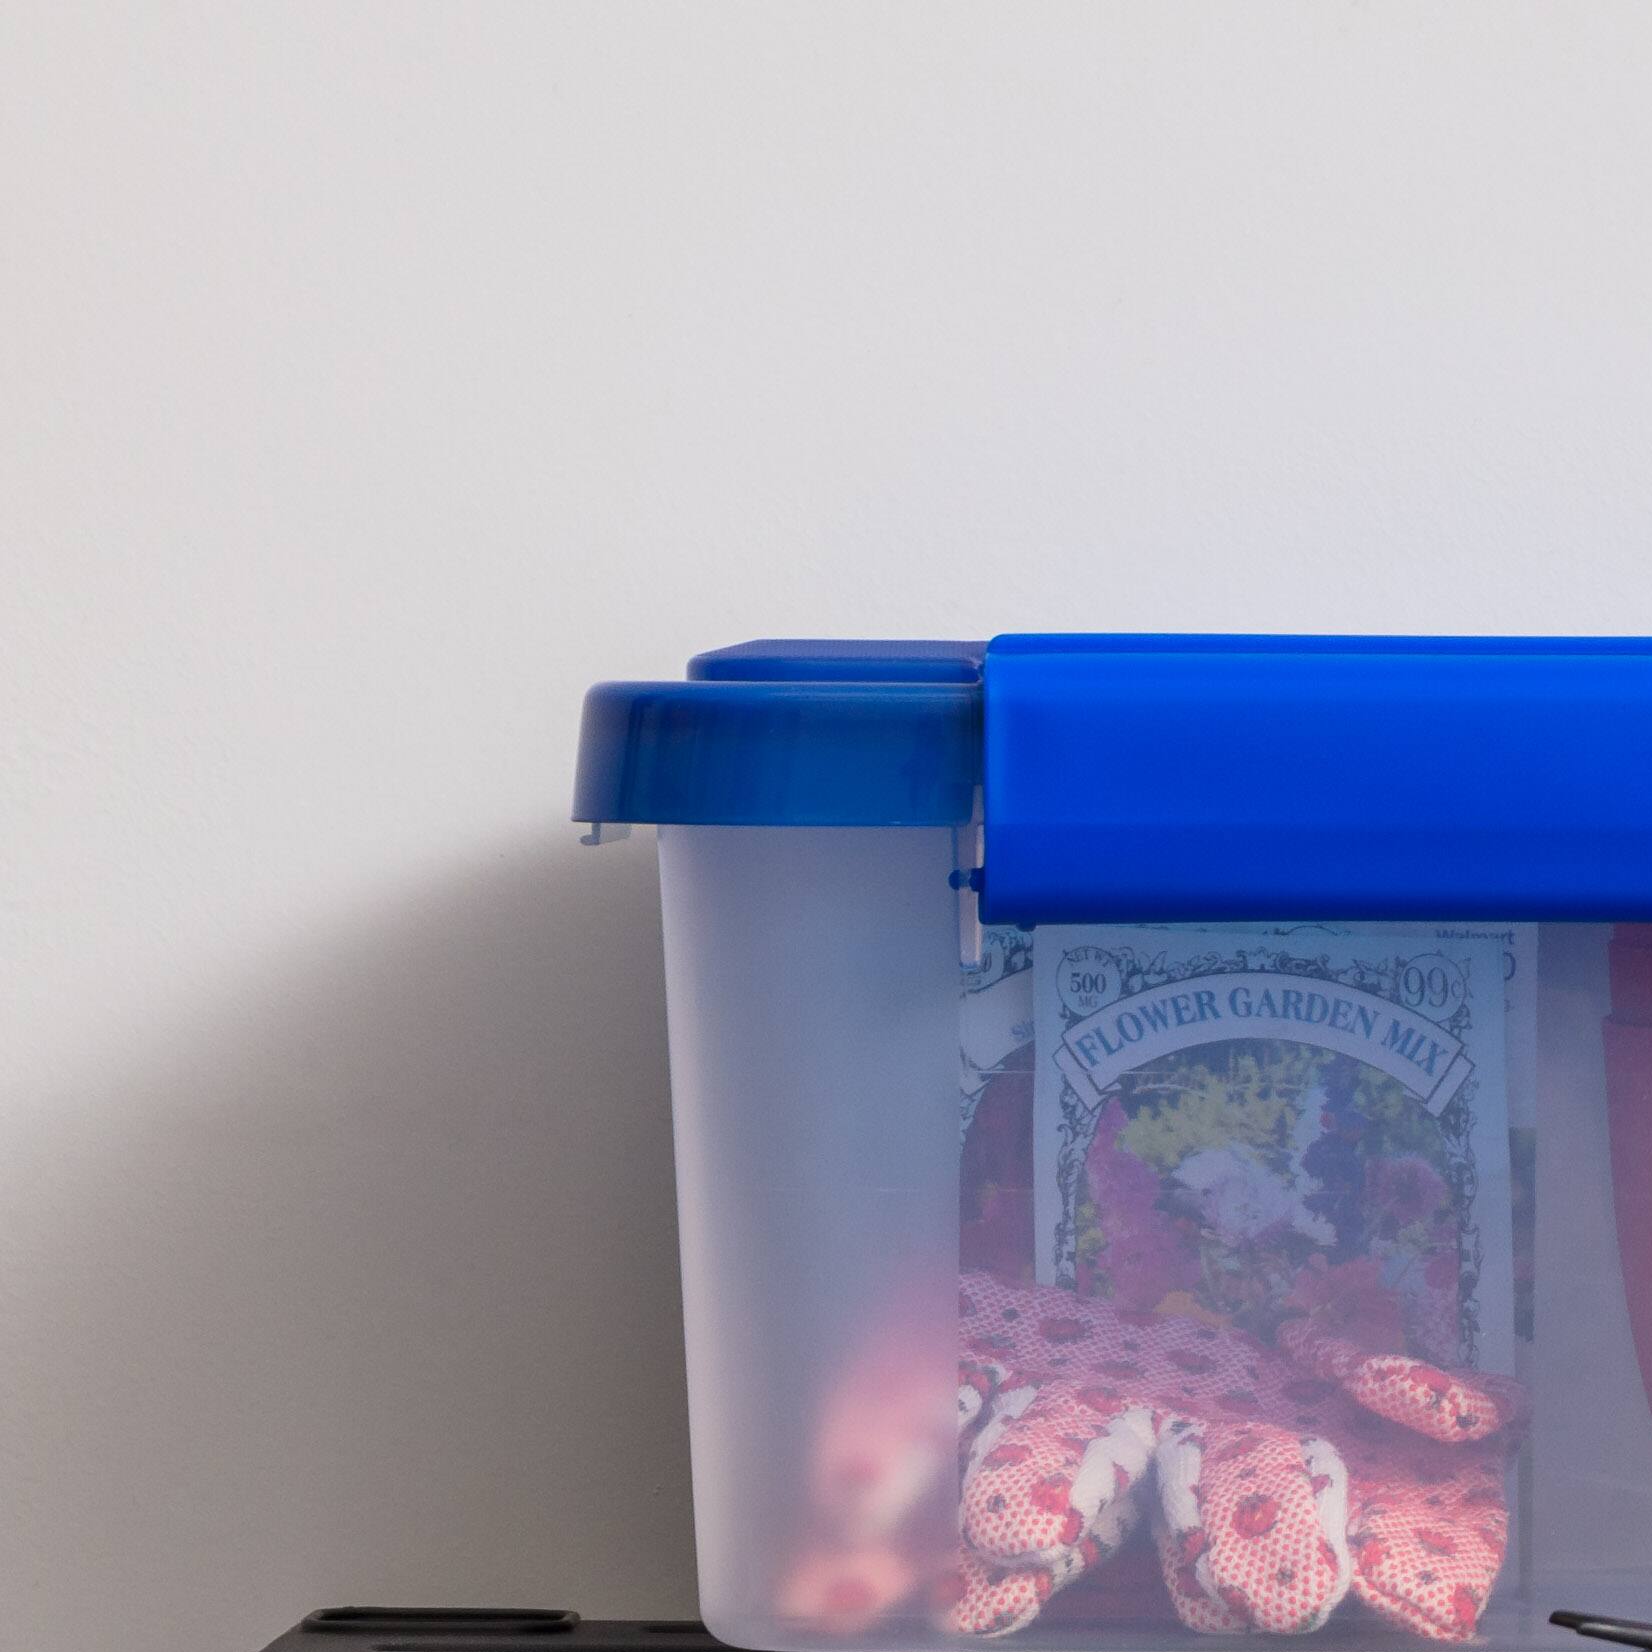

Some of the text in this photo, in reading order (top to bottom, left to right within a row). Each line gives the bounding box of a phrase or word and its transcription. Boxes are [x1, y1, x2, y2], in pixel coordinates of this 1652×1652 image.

[1070, 972, 1107, 994] 500
[1074, 989, 1221, 1067] FLOWER
[1229, 987, 1381, 1037] GARDEN
[1379, 1018, 1449, 1077] MIX
